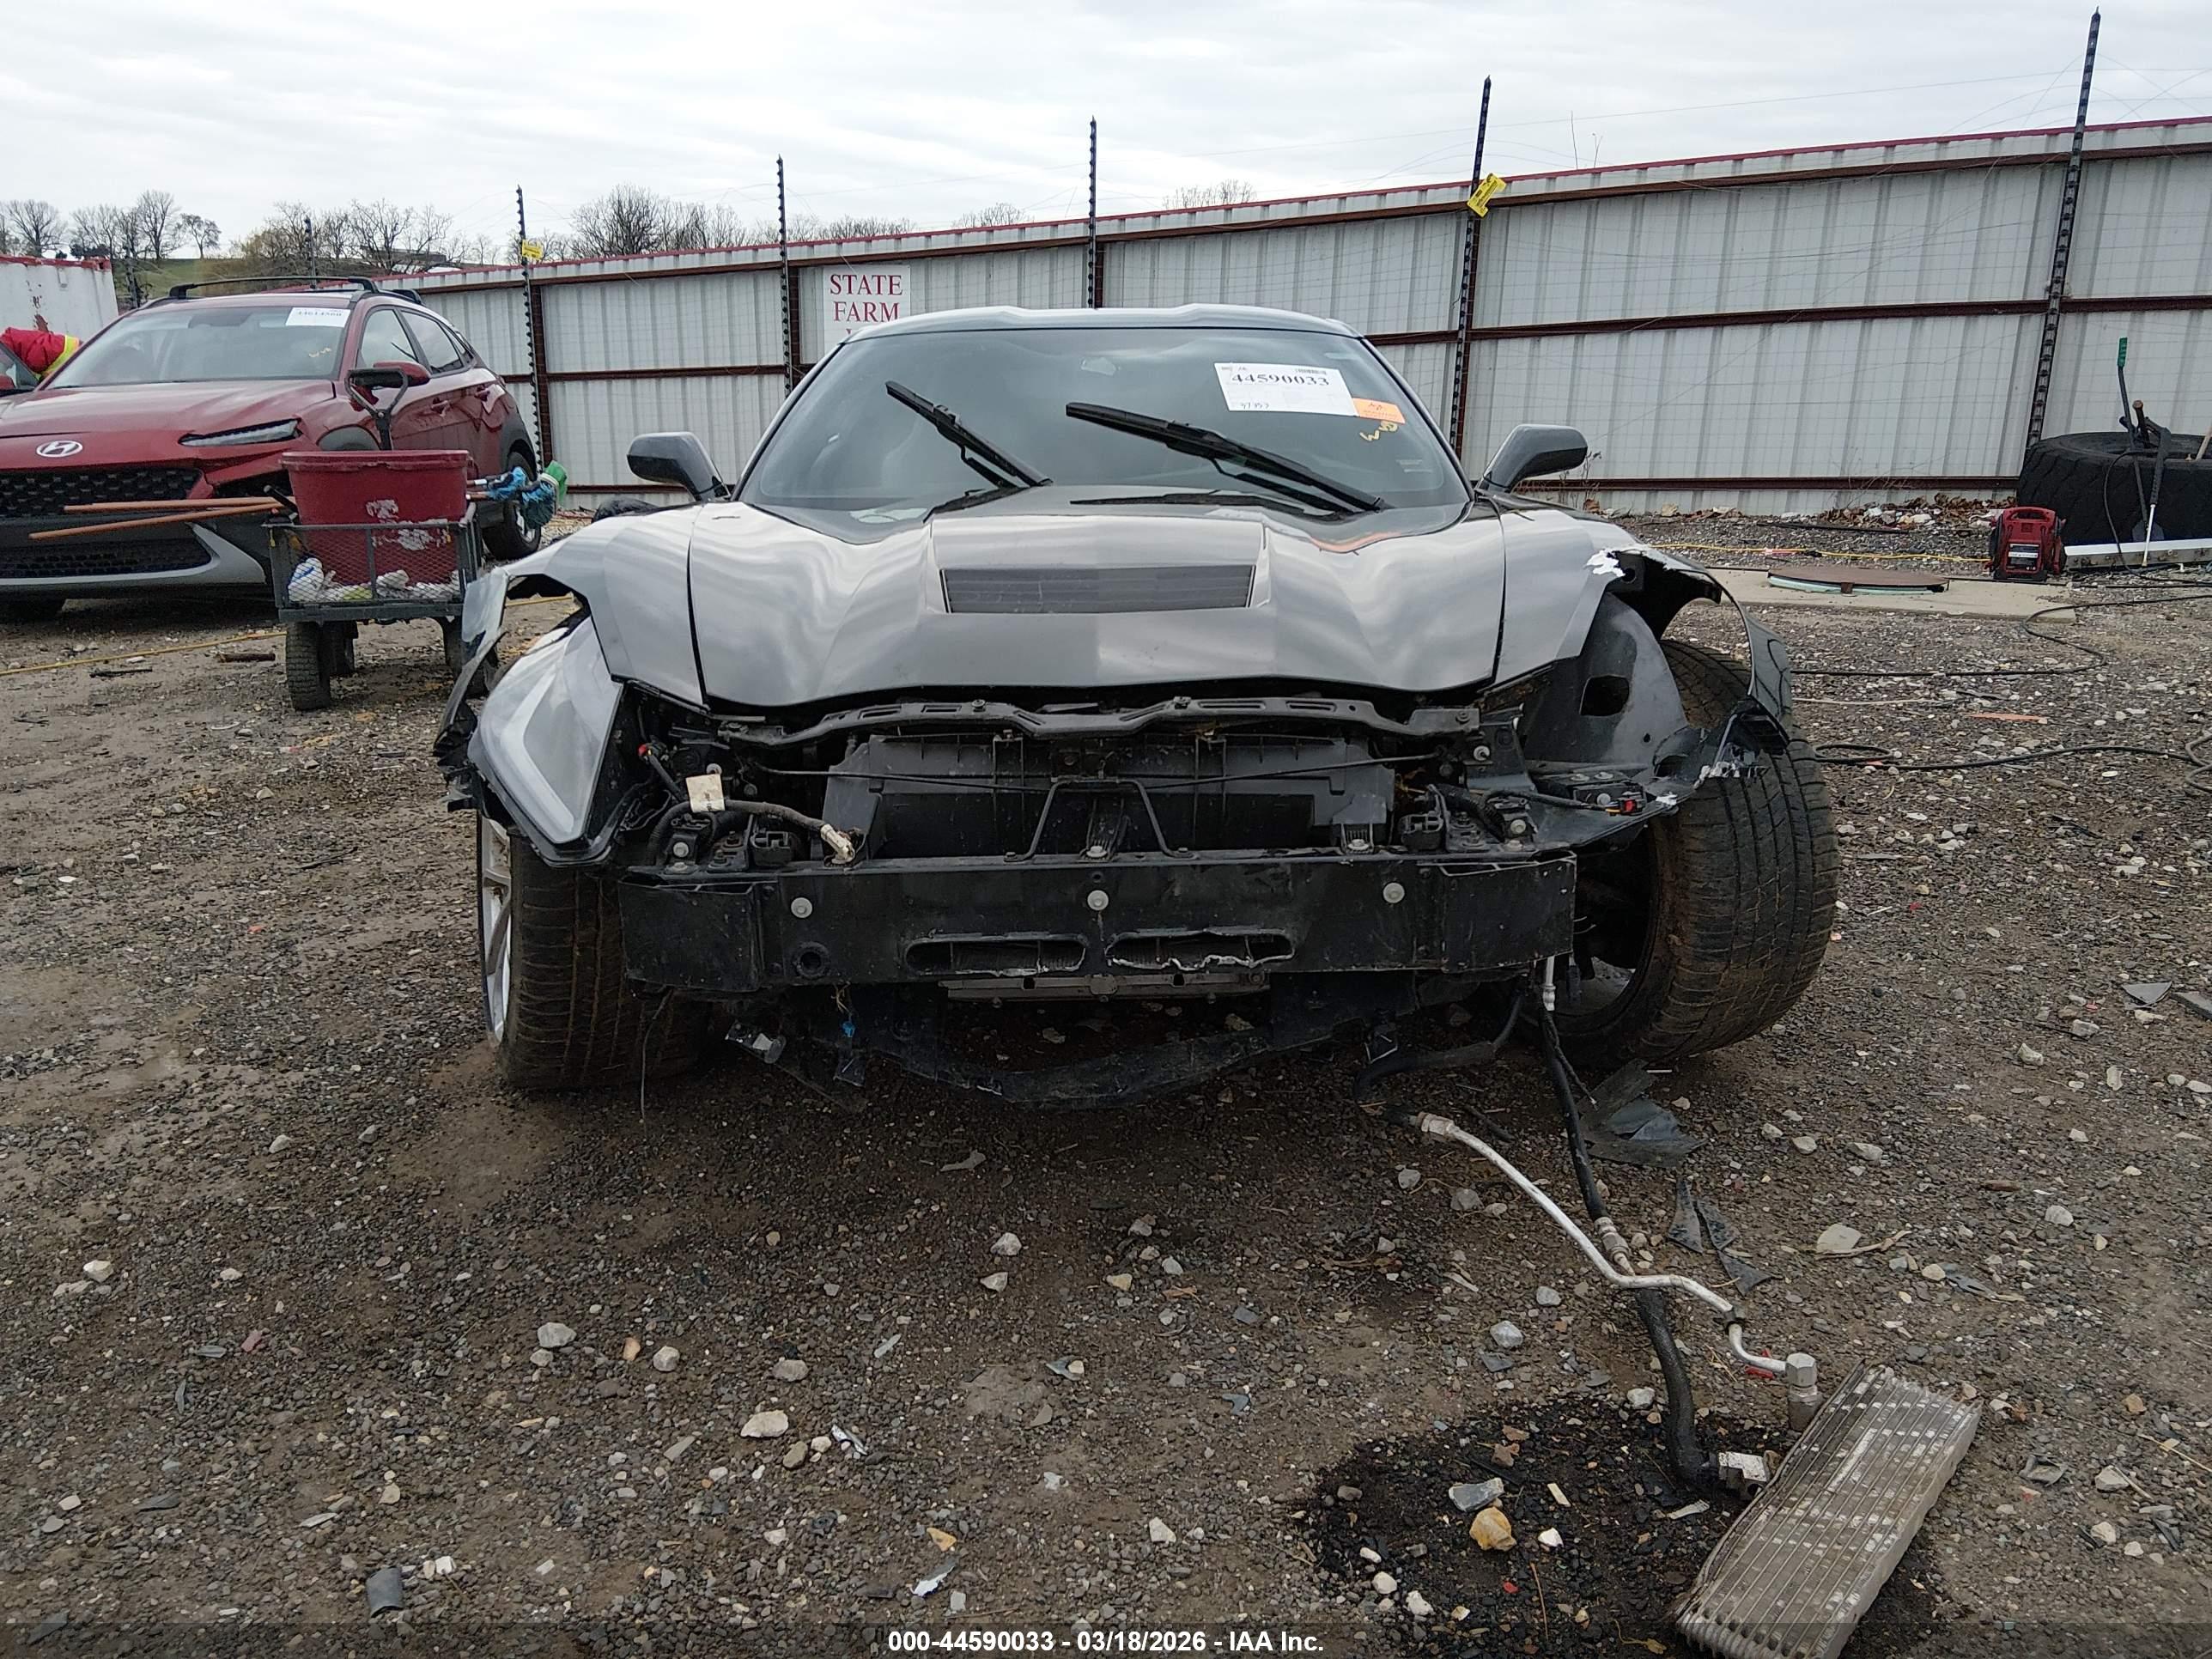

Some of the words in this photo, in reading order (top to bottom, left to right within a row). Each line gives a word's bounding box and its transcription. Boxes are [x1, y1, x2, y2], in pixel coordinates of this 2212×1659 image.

[830, 274, 903, 295] STATE
[834, 301, 900, 322] FARM
[1231, 373, 1330, 386] 44590033
